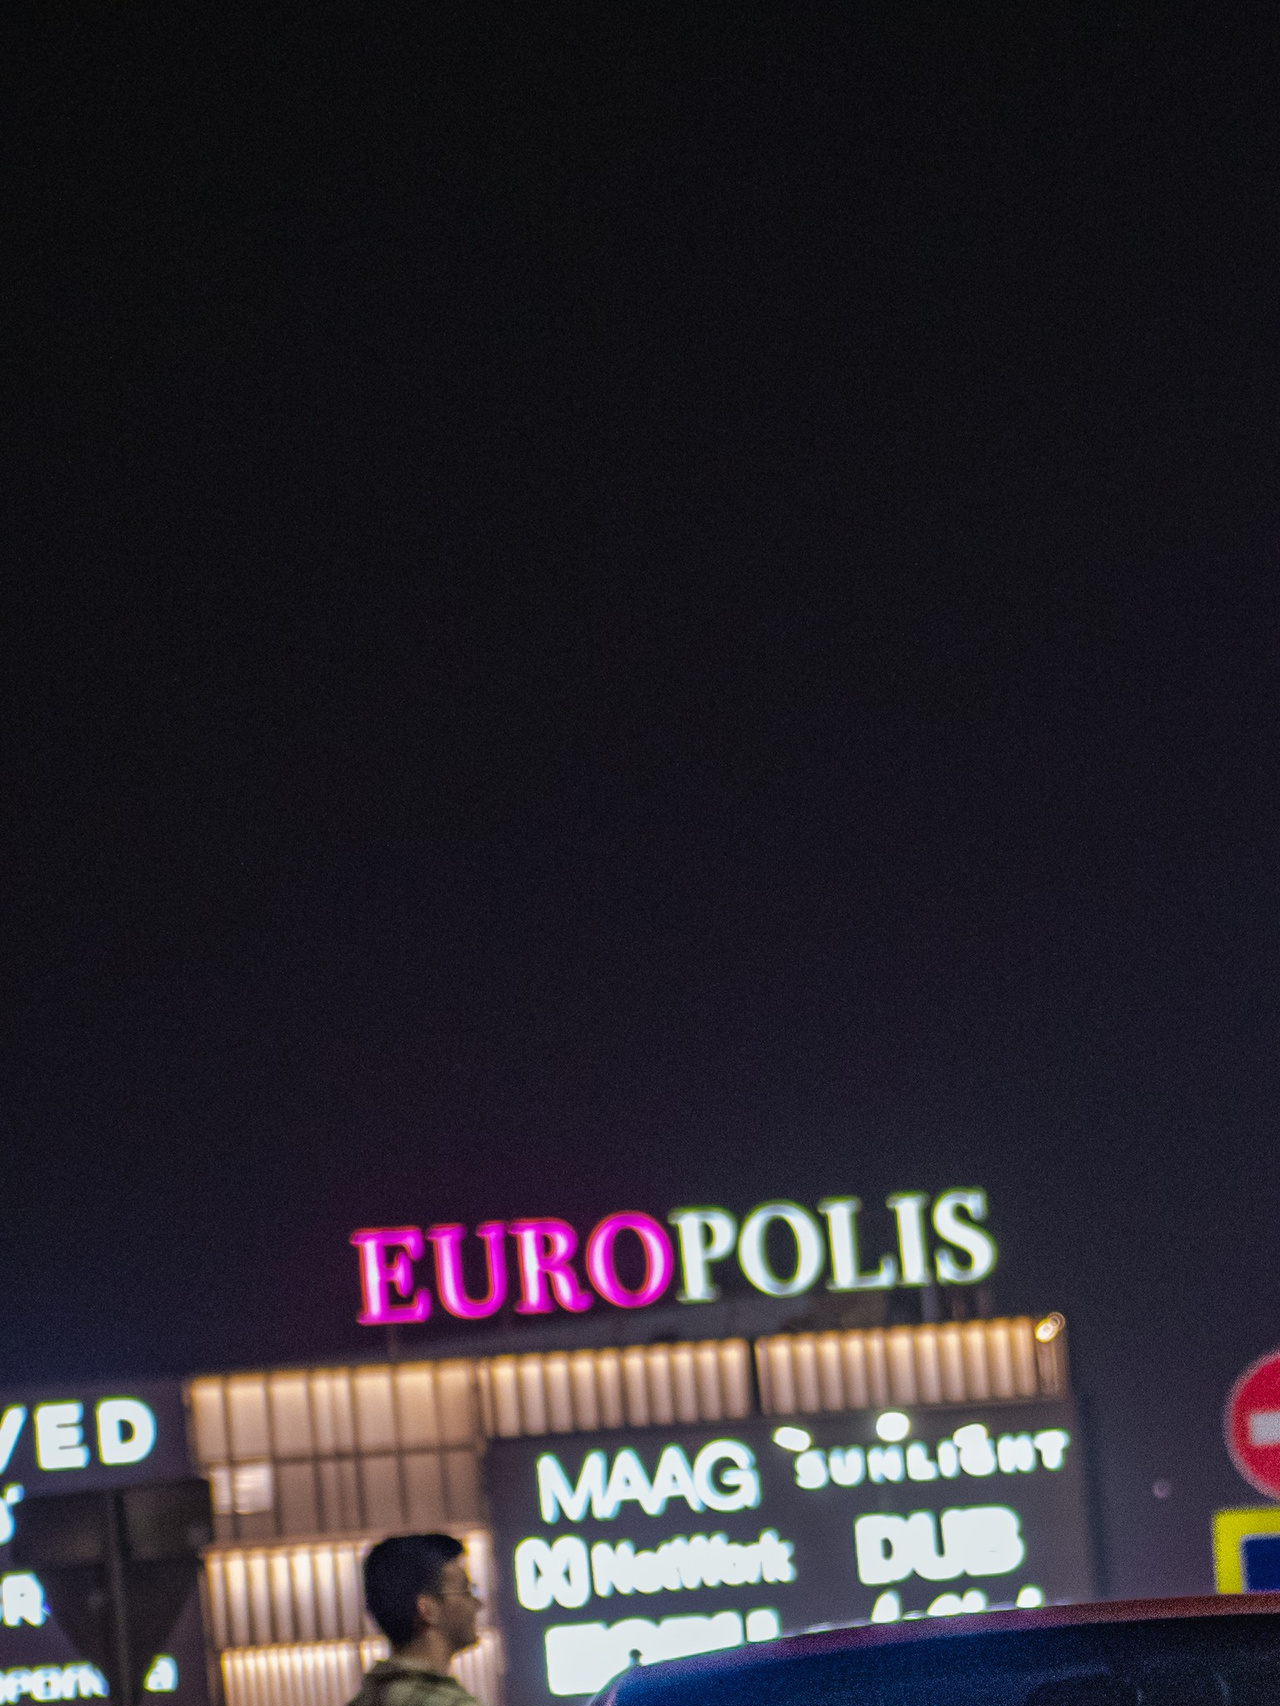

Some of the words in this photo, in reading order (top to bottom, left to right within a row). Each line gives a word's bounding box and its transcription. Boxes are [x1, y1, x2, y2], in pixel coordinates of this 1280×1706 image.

[350, 1187, 997, 1325] EUROPOLIS
[536, 1439, 762, 1524] MAAG
[794, 1428, 1071, 1490] SUNLIGHT
[854, 1504, 1026, 1586] DUB
